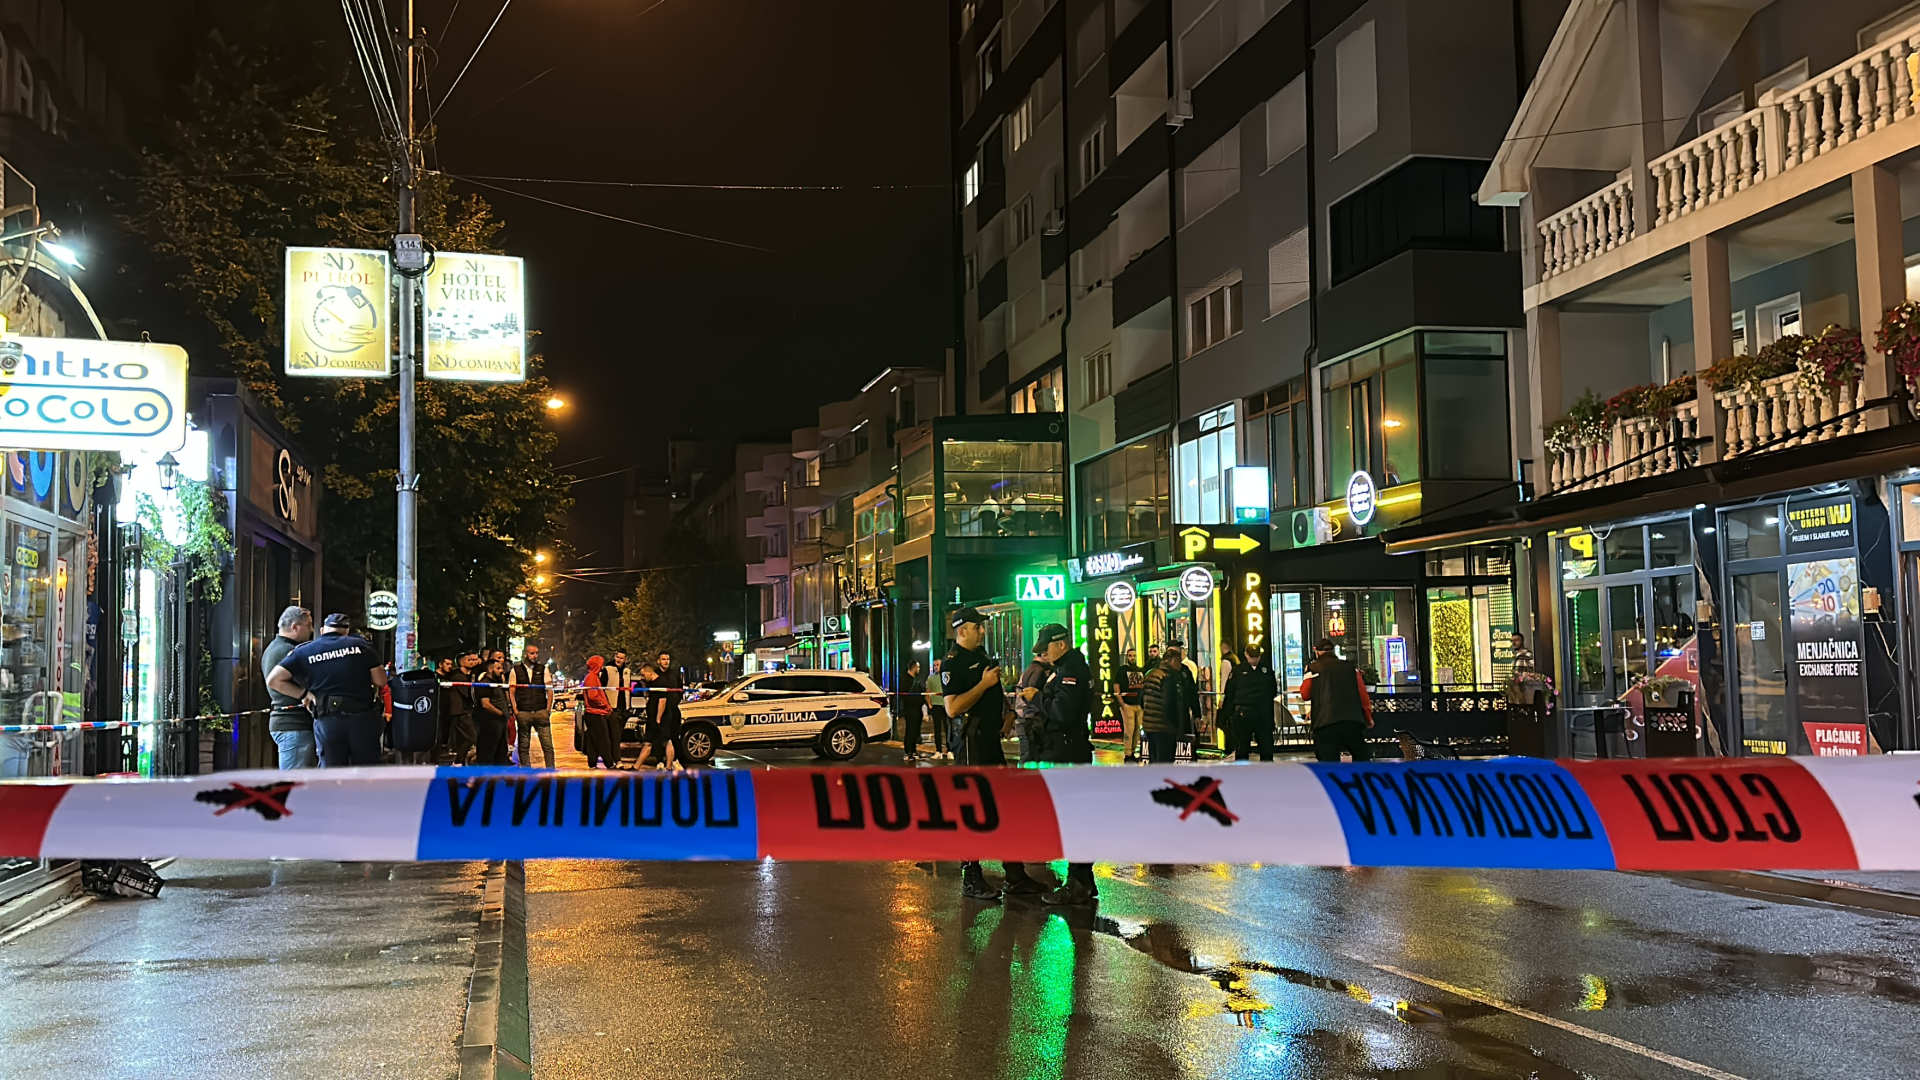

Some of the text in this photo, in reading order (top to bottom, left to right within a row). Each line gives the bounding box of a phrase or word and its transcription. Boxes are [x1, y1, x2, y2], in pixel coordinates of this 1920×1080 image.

[303, 271, 374, 285] PETROL
[442, 273, 506, 288] HOTEL
[440, 288, 506, 303] VRBAK
[330, 359, 381, 370] COMPANY
[459, 359, 520, 371] COMPANY
[0, 394, 159, 426] oCoLo
[1789, 507, 1825, 520] WESTERN
[1801, 517, 1826, 529] UNION
[1185, 534, 1207, 560] P
[370, 607, 398, 616] ERVIS
[308, 646, 362, 664] ПОЛИЦИЈА
[1797, 638, 1859, 660] MENJAČNICA
[1800, 663, 1859, 676] EXCHANGE OFFICE
[750, 711, 818, 724] ПОЛИЦИЈА
[1815, 728, 1861, 744] PLAĆANJE
[811, 773, 1000, 833] СТОП
[1327, 768, 1594, 840] ПОЛИЦИЈА
[1621, 773, 1802, 843] СТОП
